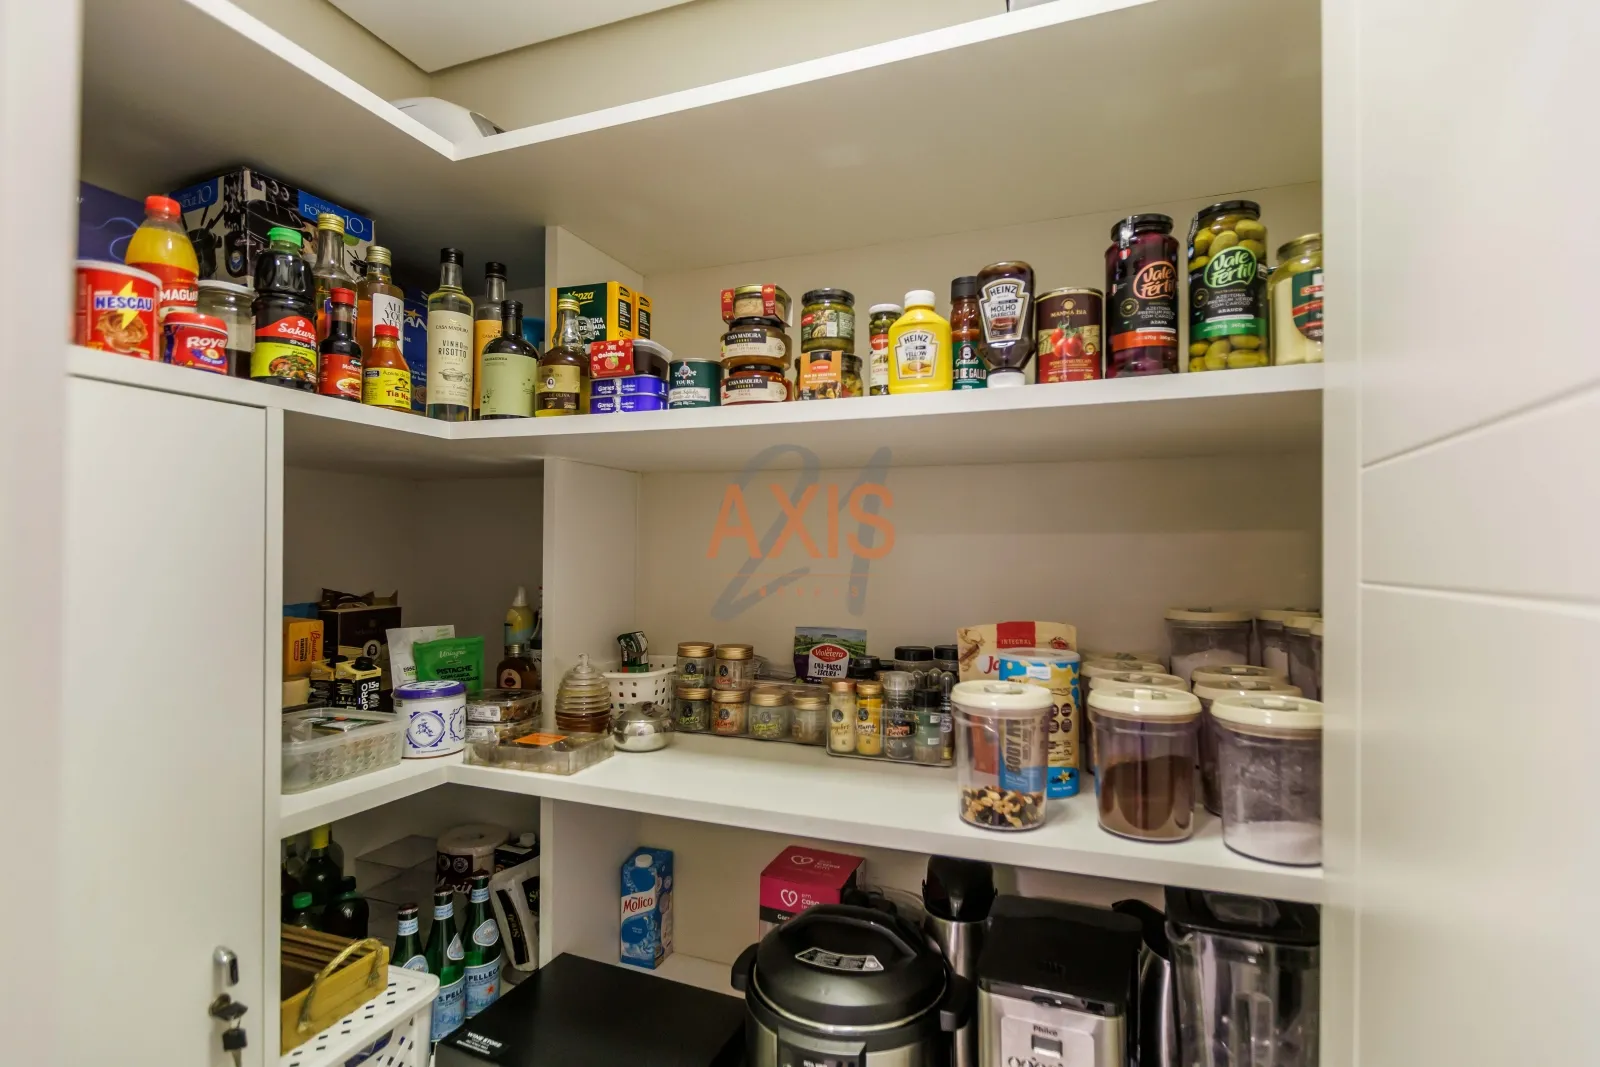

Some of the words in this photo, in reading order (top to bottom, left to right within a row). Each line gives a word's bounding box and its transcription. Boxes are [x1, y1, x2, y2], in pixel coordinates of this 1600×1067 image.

[1213, 250, 1249, 271] Vale
[1143, 266, 1172, 284] Vale
[159, 288, 199, 302] MAGUA
[990, 285, 1017, 297] HEINZ
[94, 295, 154, 312] NESCAU
[990, 304, 1017, 313] MOLHO
[277, 322, 316, 341] Sakura
[186, 335, 228, 349] Royal
[442, 339, 464, 349] VINHO
[904, 334, 929, 344] HEINZ
[438, 348, 467, 359] RISOTTO
[968, 367, 987, 380] GALLO
[815, 649, 844, 658] Violetera
[436, 664, 474, 675] PISTACHE
[361, 683, 369, 711] oPRO
[622, 896, 653, 914] Molico
[1032, 1024, 1058, 1037] Philco
